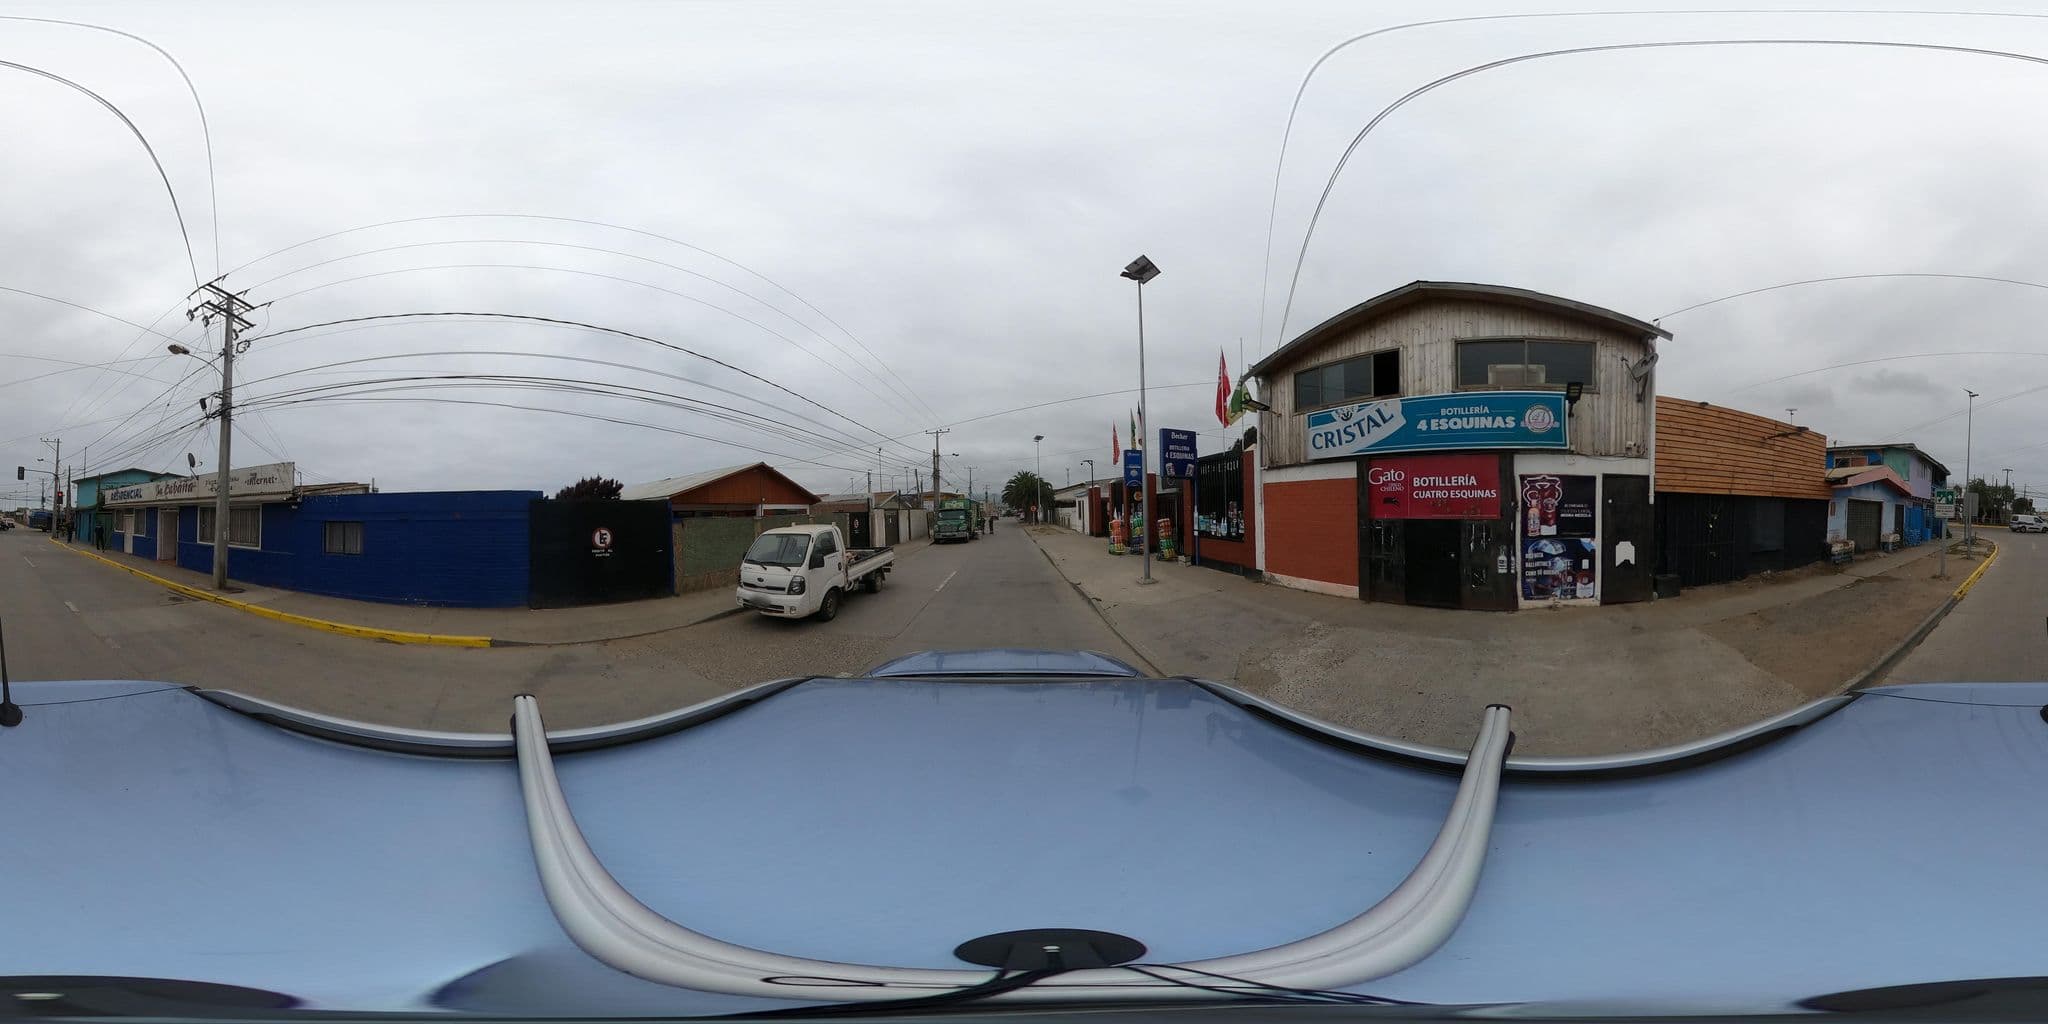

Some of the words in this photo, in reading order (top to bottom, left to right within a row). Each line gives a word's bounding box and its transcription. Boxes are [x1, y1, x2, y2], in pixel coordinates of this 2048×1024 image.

[1441, 405, 1490, 416] BOTILLERÍA
[1312, 408, 1394, 450] CRISTAL
[1417, 419, 1428, 431] 4
[1431, 416, 1516, 431] ESQUINAS
[1169, 452, 1195, 460] ESQUINAS
[1368, 467, 1405, 485] Gato
[1413, 474, 1477, 487] BOTILLERÍA
[1413, 490, 1448, 498] CUATRO
[1450, 489, 1497, 498] ESQUINAS
